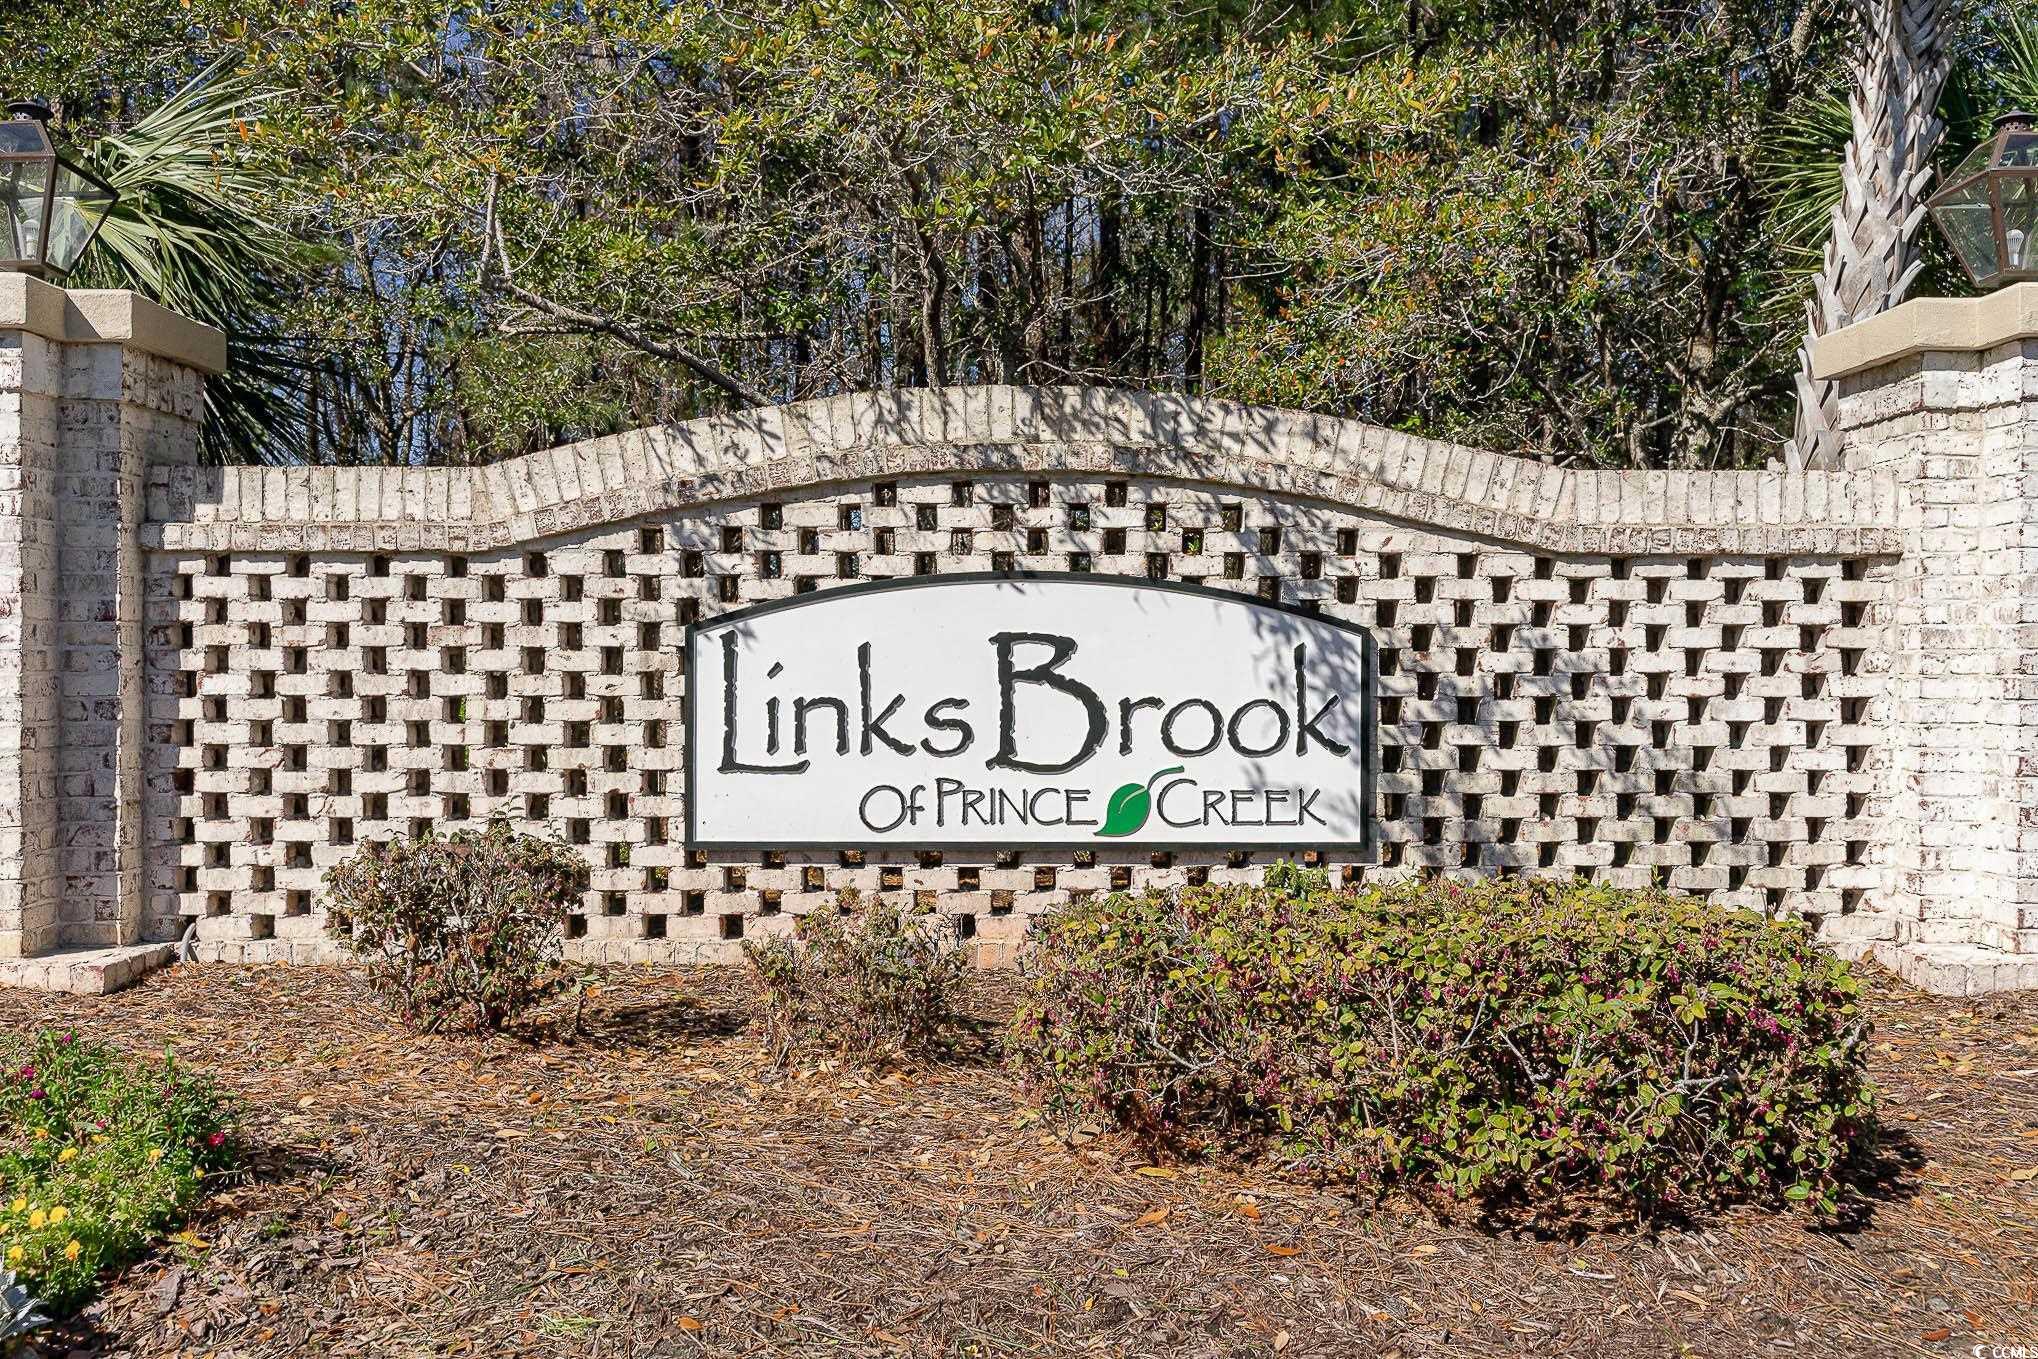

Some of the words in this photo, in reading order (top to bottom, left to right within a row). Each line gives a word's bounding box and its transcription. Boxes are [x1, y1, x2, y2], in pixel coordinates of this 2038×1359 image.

[985, 631, 1351, 776] Brook
[934, 776, 1099, 828] PRINCE
[1156, 777, 1328, 828] CREEK
